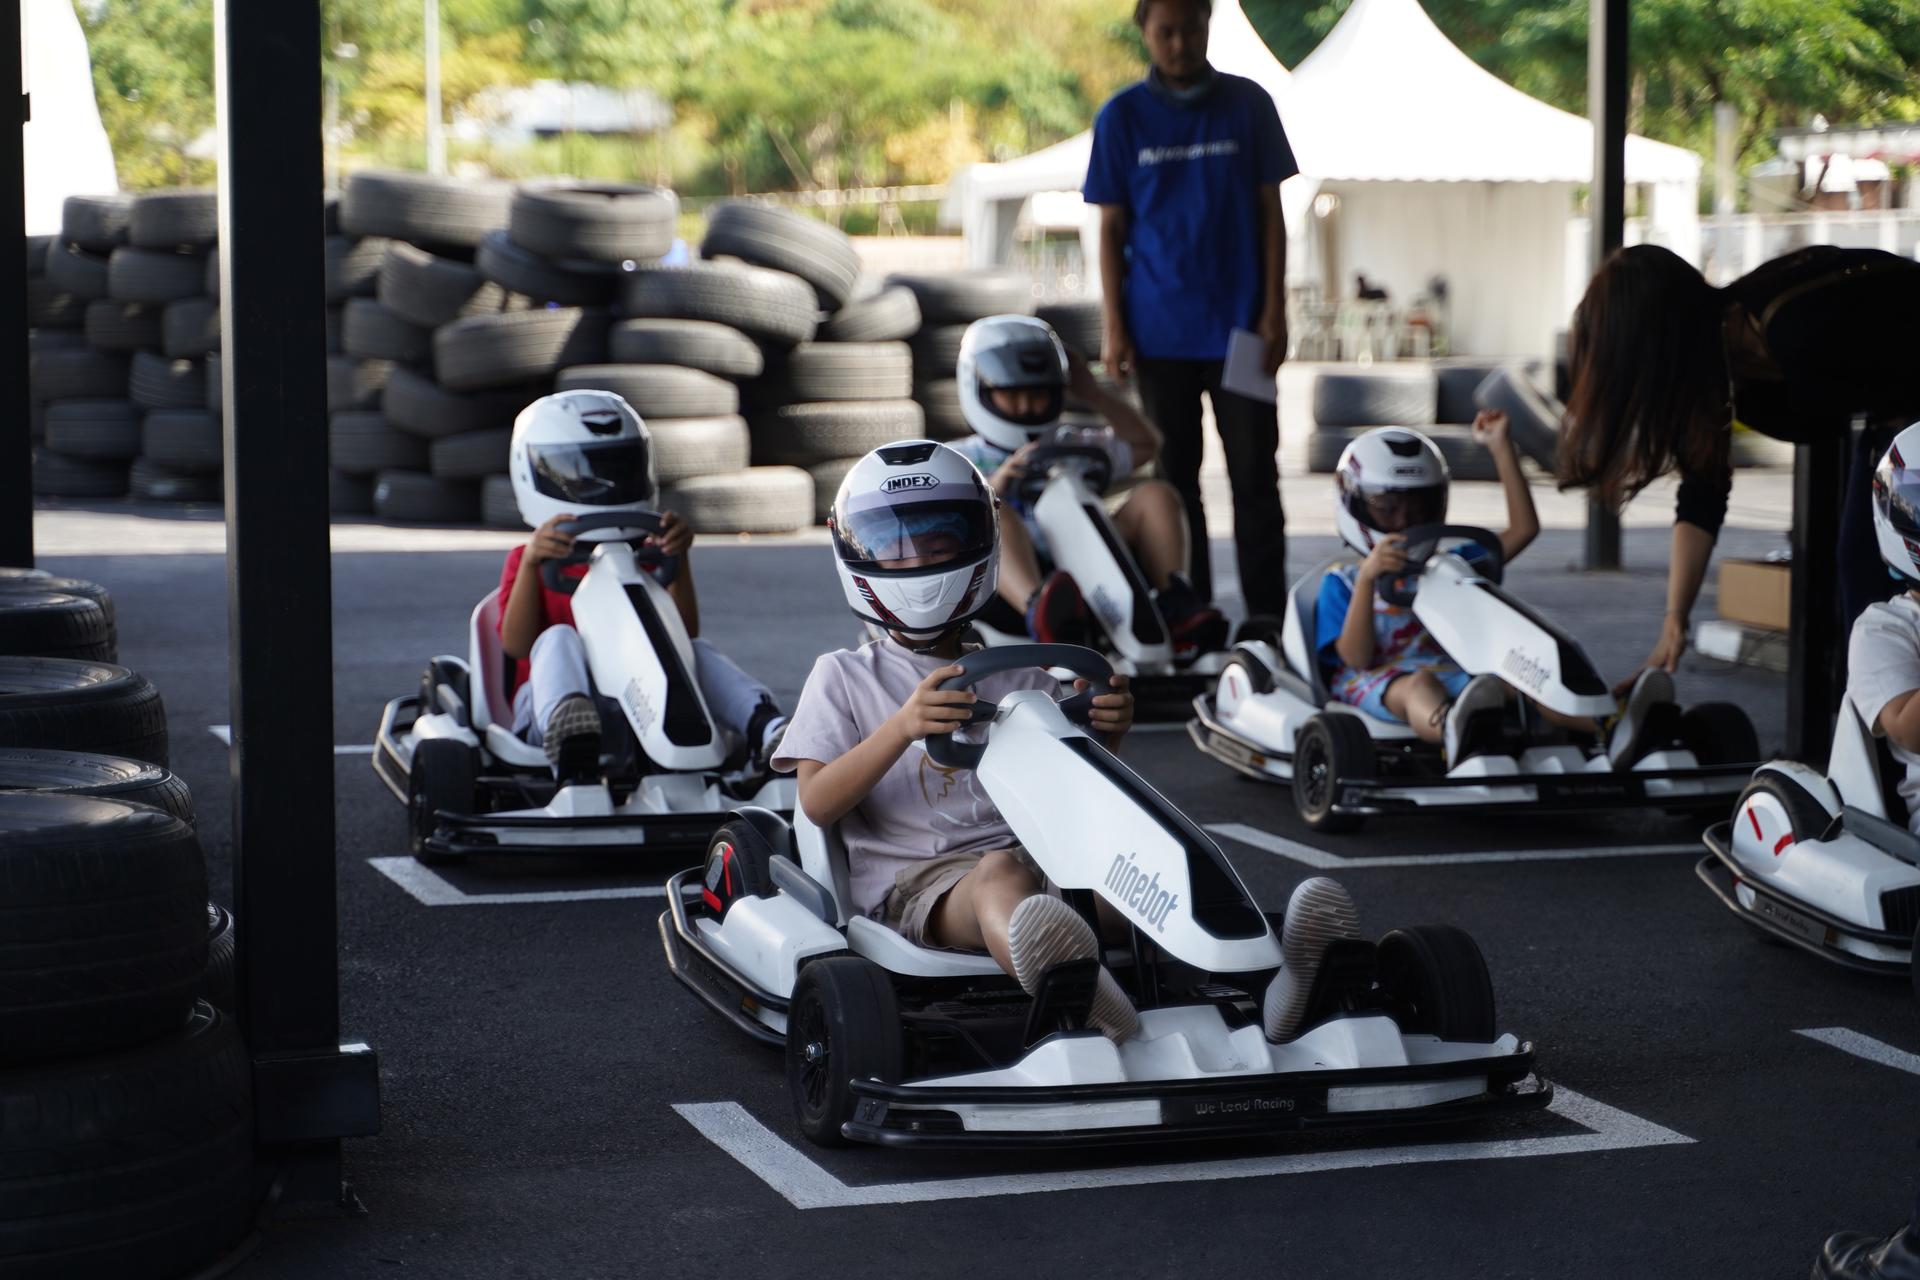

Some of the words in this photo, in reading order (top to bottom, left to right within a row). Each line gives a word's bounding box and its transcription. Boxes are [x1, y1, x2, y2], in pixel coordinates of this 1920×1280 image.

[887, 476, 932, 491] INDEX
[1104, 852, 1179, 934] ninebot
[1195, 1102, 1217, 1115] We
[1220, 1100, 1250, 1113] Lead
[1253, 1097, 1295, 1113] Racing
